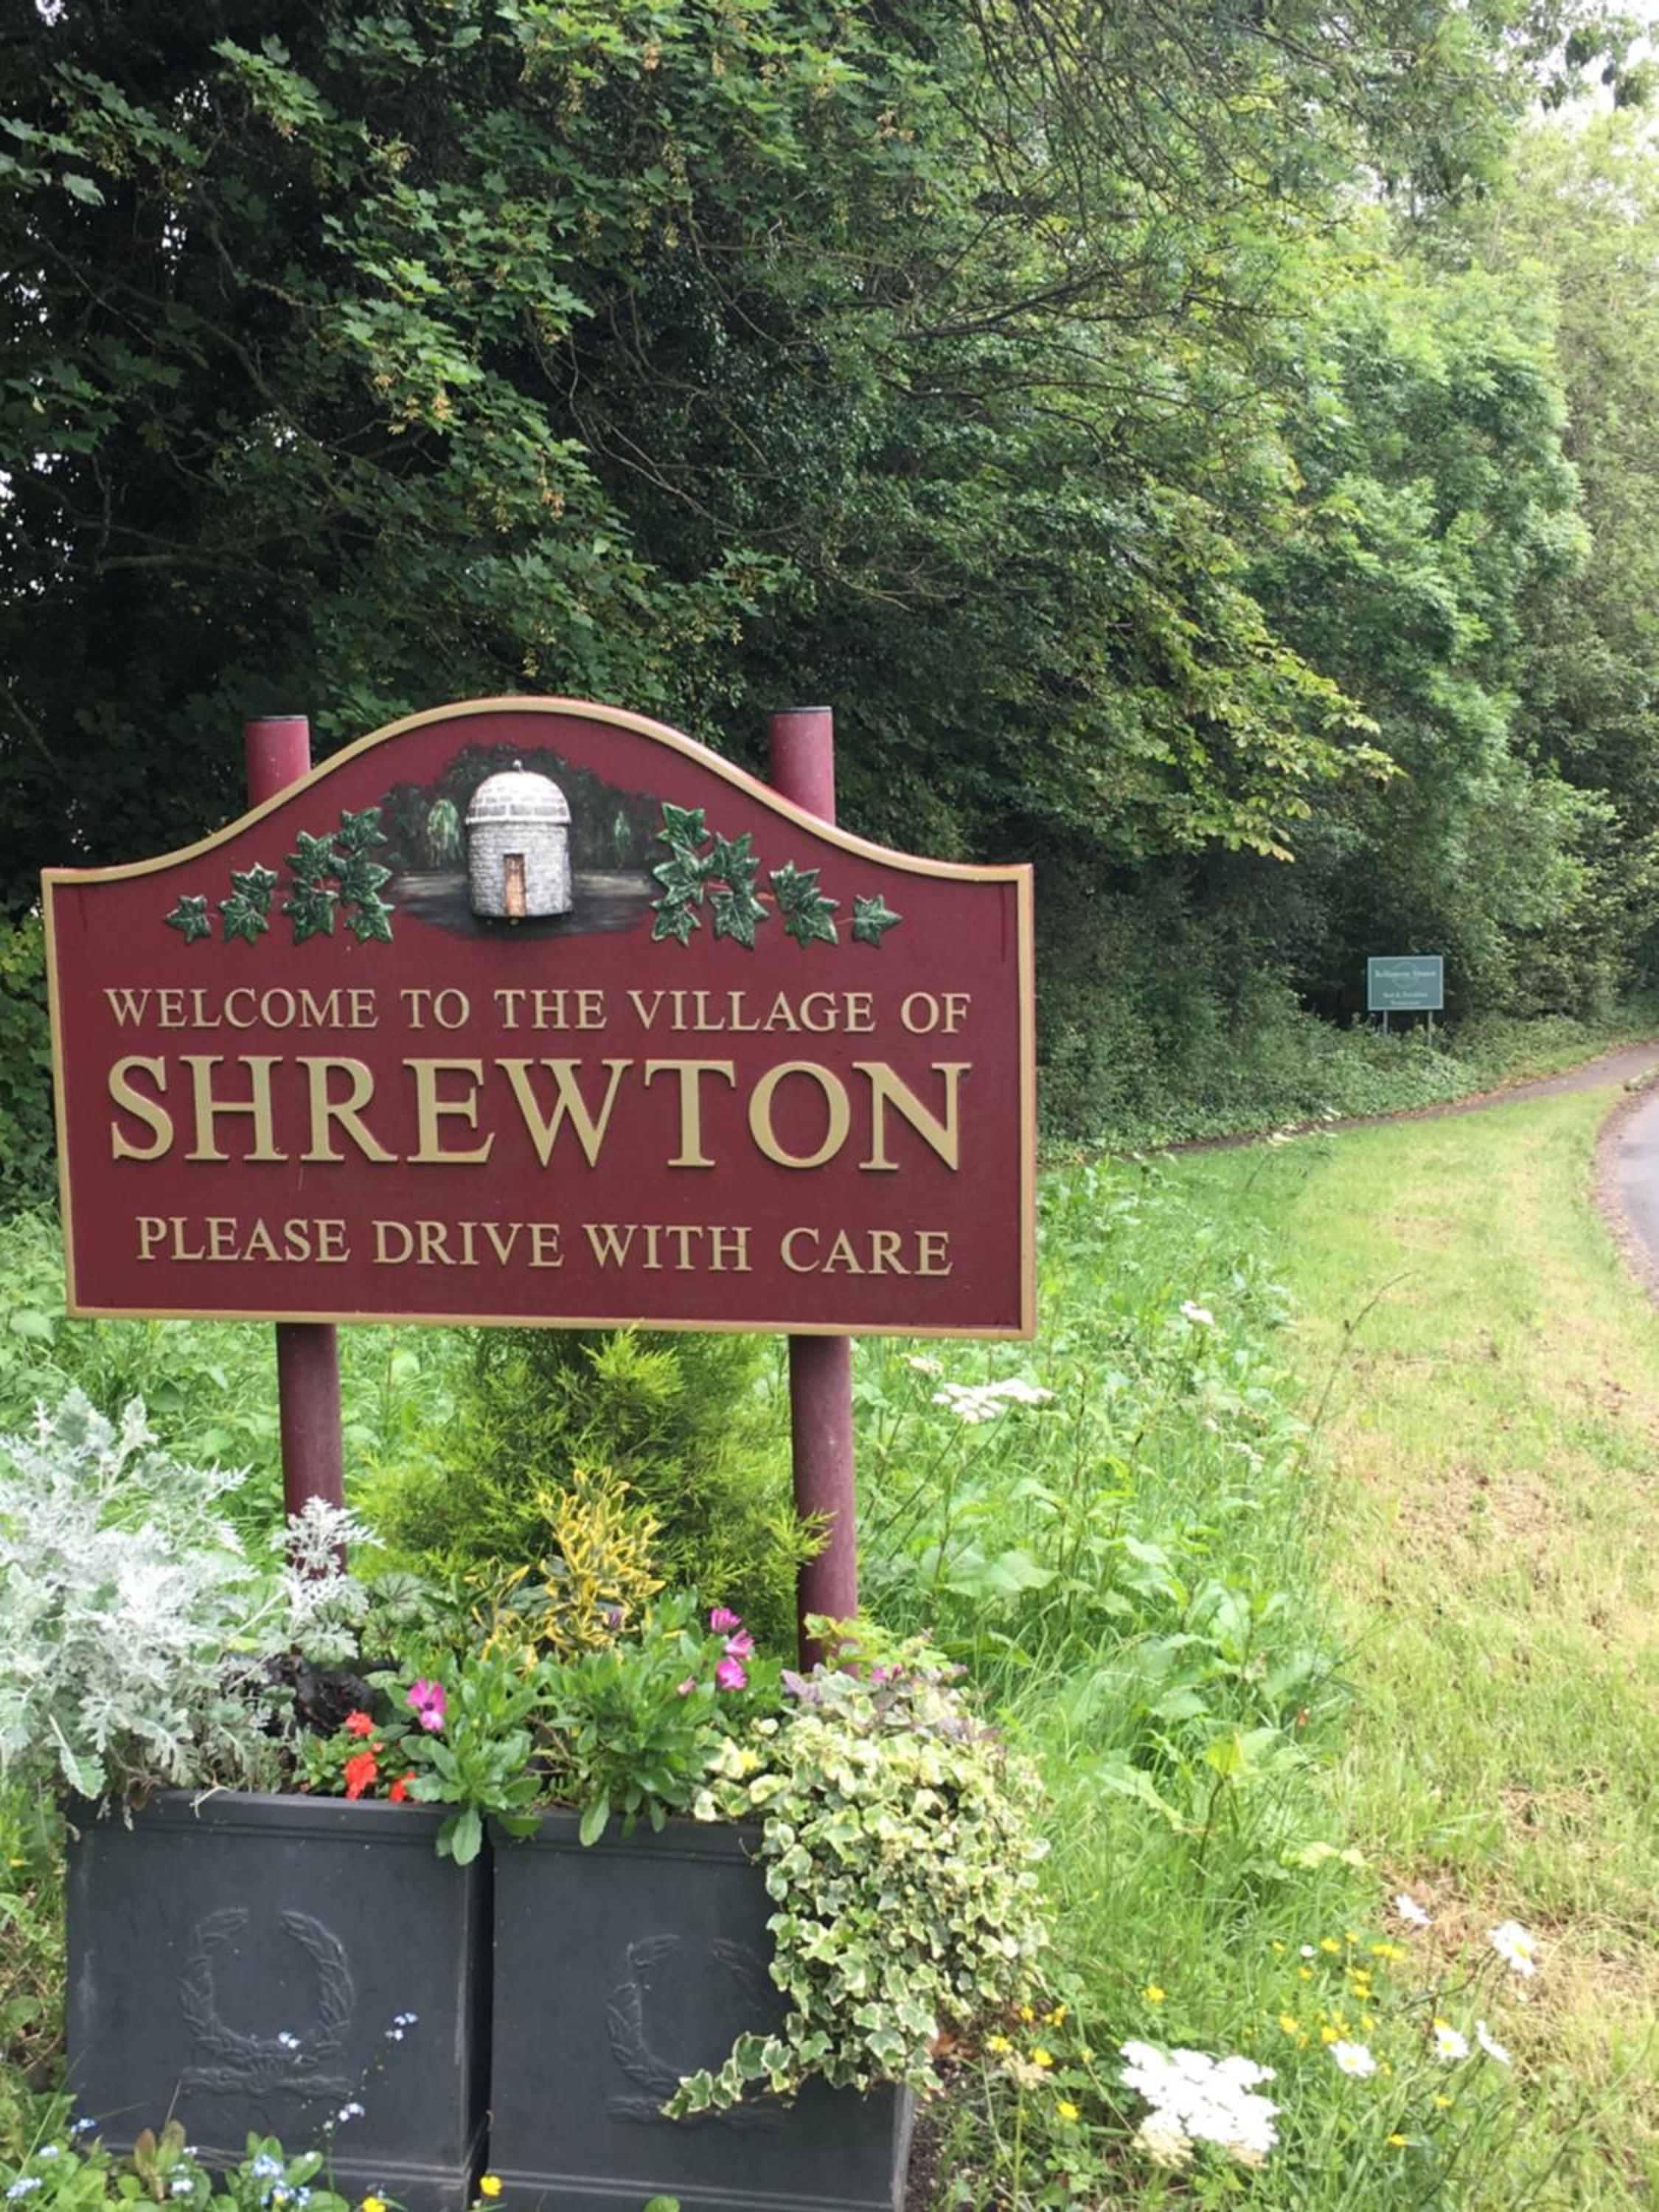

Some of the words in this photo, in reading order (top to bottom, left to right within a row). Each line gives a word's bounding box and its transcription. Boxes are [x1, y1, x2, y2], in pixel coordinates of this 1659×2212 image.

[104, 988, 379, 1029] WELCOME
[400, 989, 470, 1029] TO
[494, 990, 608, 1030] THE
[627, 991, 876, 1032] VILLAGE
[900, 992, 972, 1034] OF
[108, 1055, 973, 1171] SHREWTON
[136, 1216, 351, 1263] PLEASE
[372, 1220, 565, 1268] DRIVE
[582, 1222, 753, 1271] WITH
[779, 1227, 953, 1276] CARE
